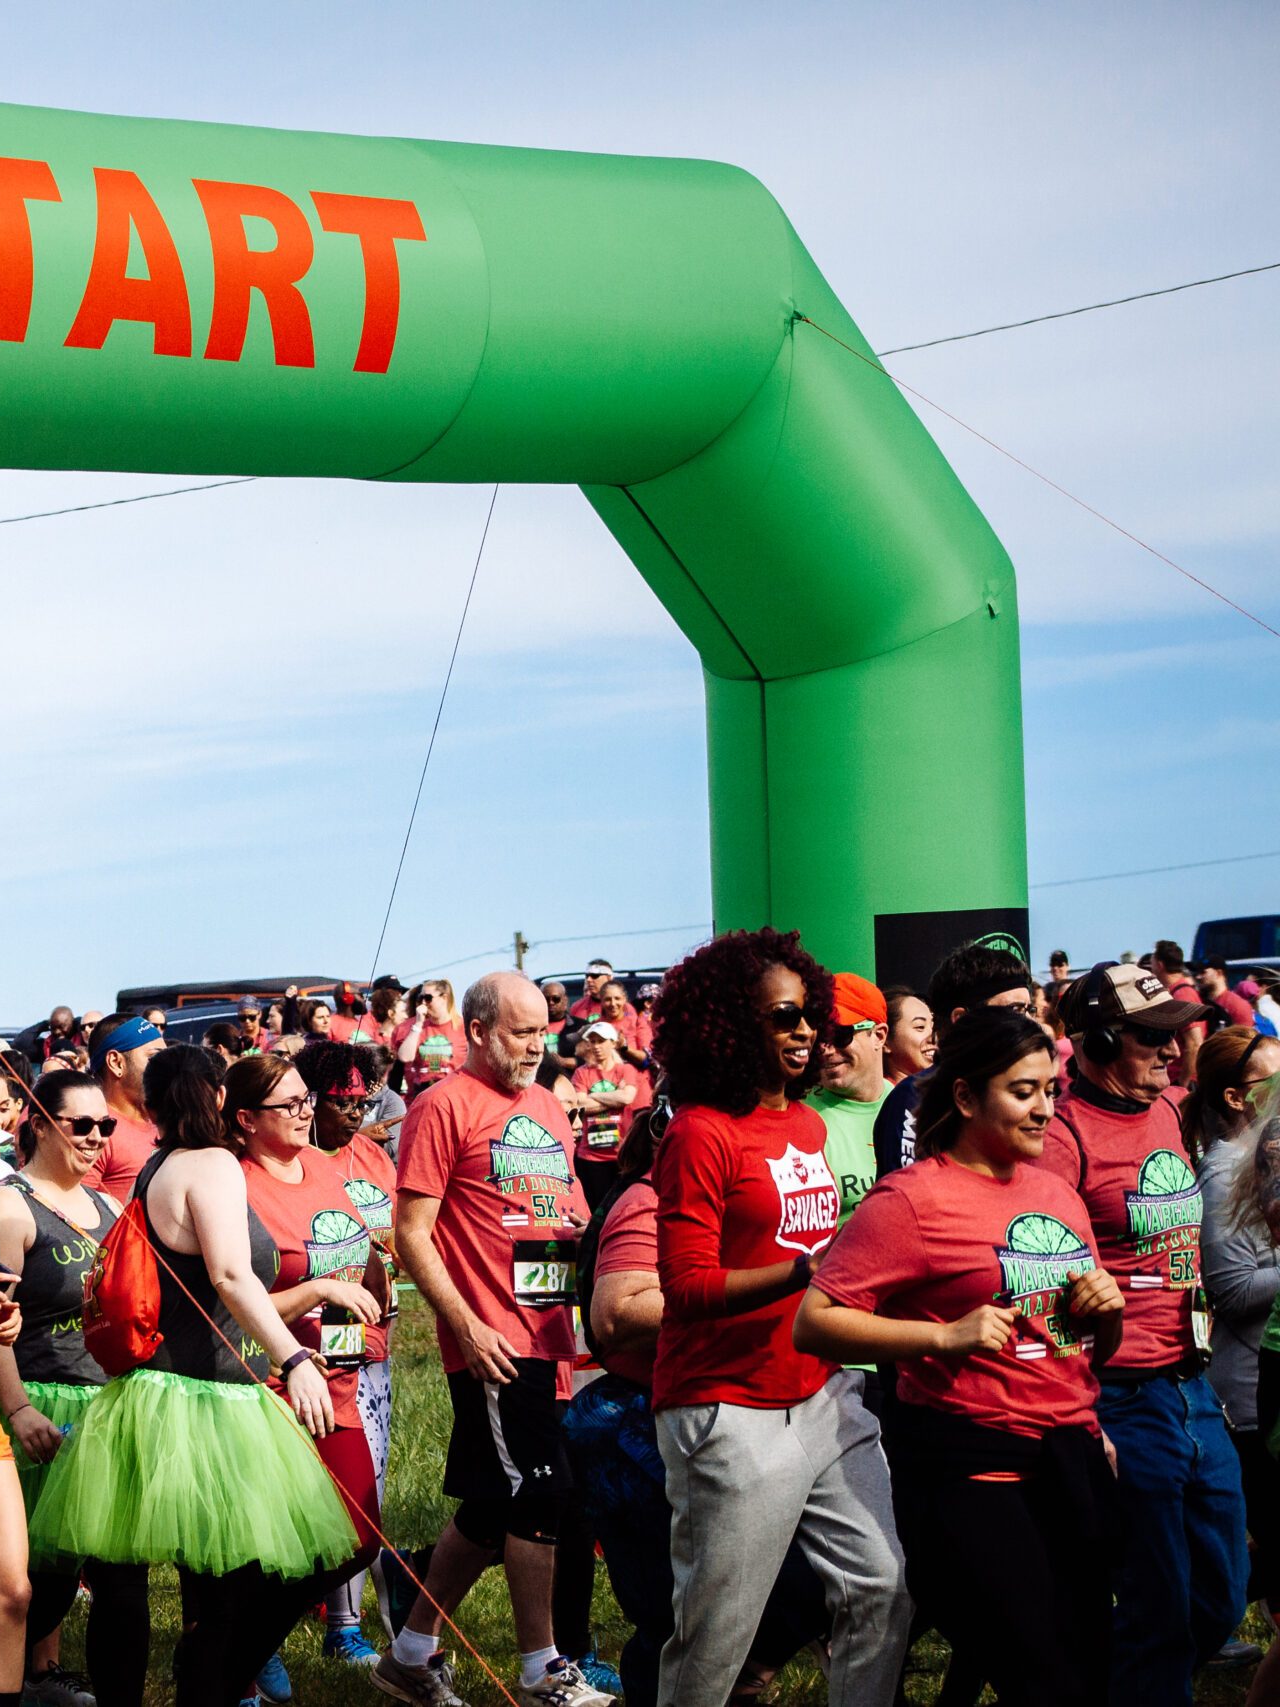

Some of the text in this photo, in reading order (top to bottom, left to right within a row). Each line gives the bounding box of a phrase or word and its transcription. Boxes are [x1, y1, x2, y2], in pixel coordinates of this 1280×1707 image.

[493, 1151, 569, 1179] MARGARITA
[501, 1177, 569, 1196] MADNESS
[531, 1194, 559, 1219] 5K
[784, 1191, 836, 1234] SAVAGE
[529, 1263, 569, 1292] 287
[1169, 1250, 1196, 1283] 5K
[333, 1326, 362, 1353] 286
